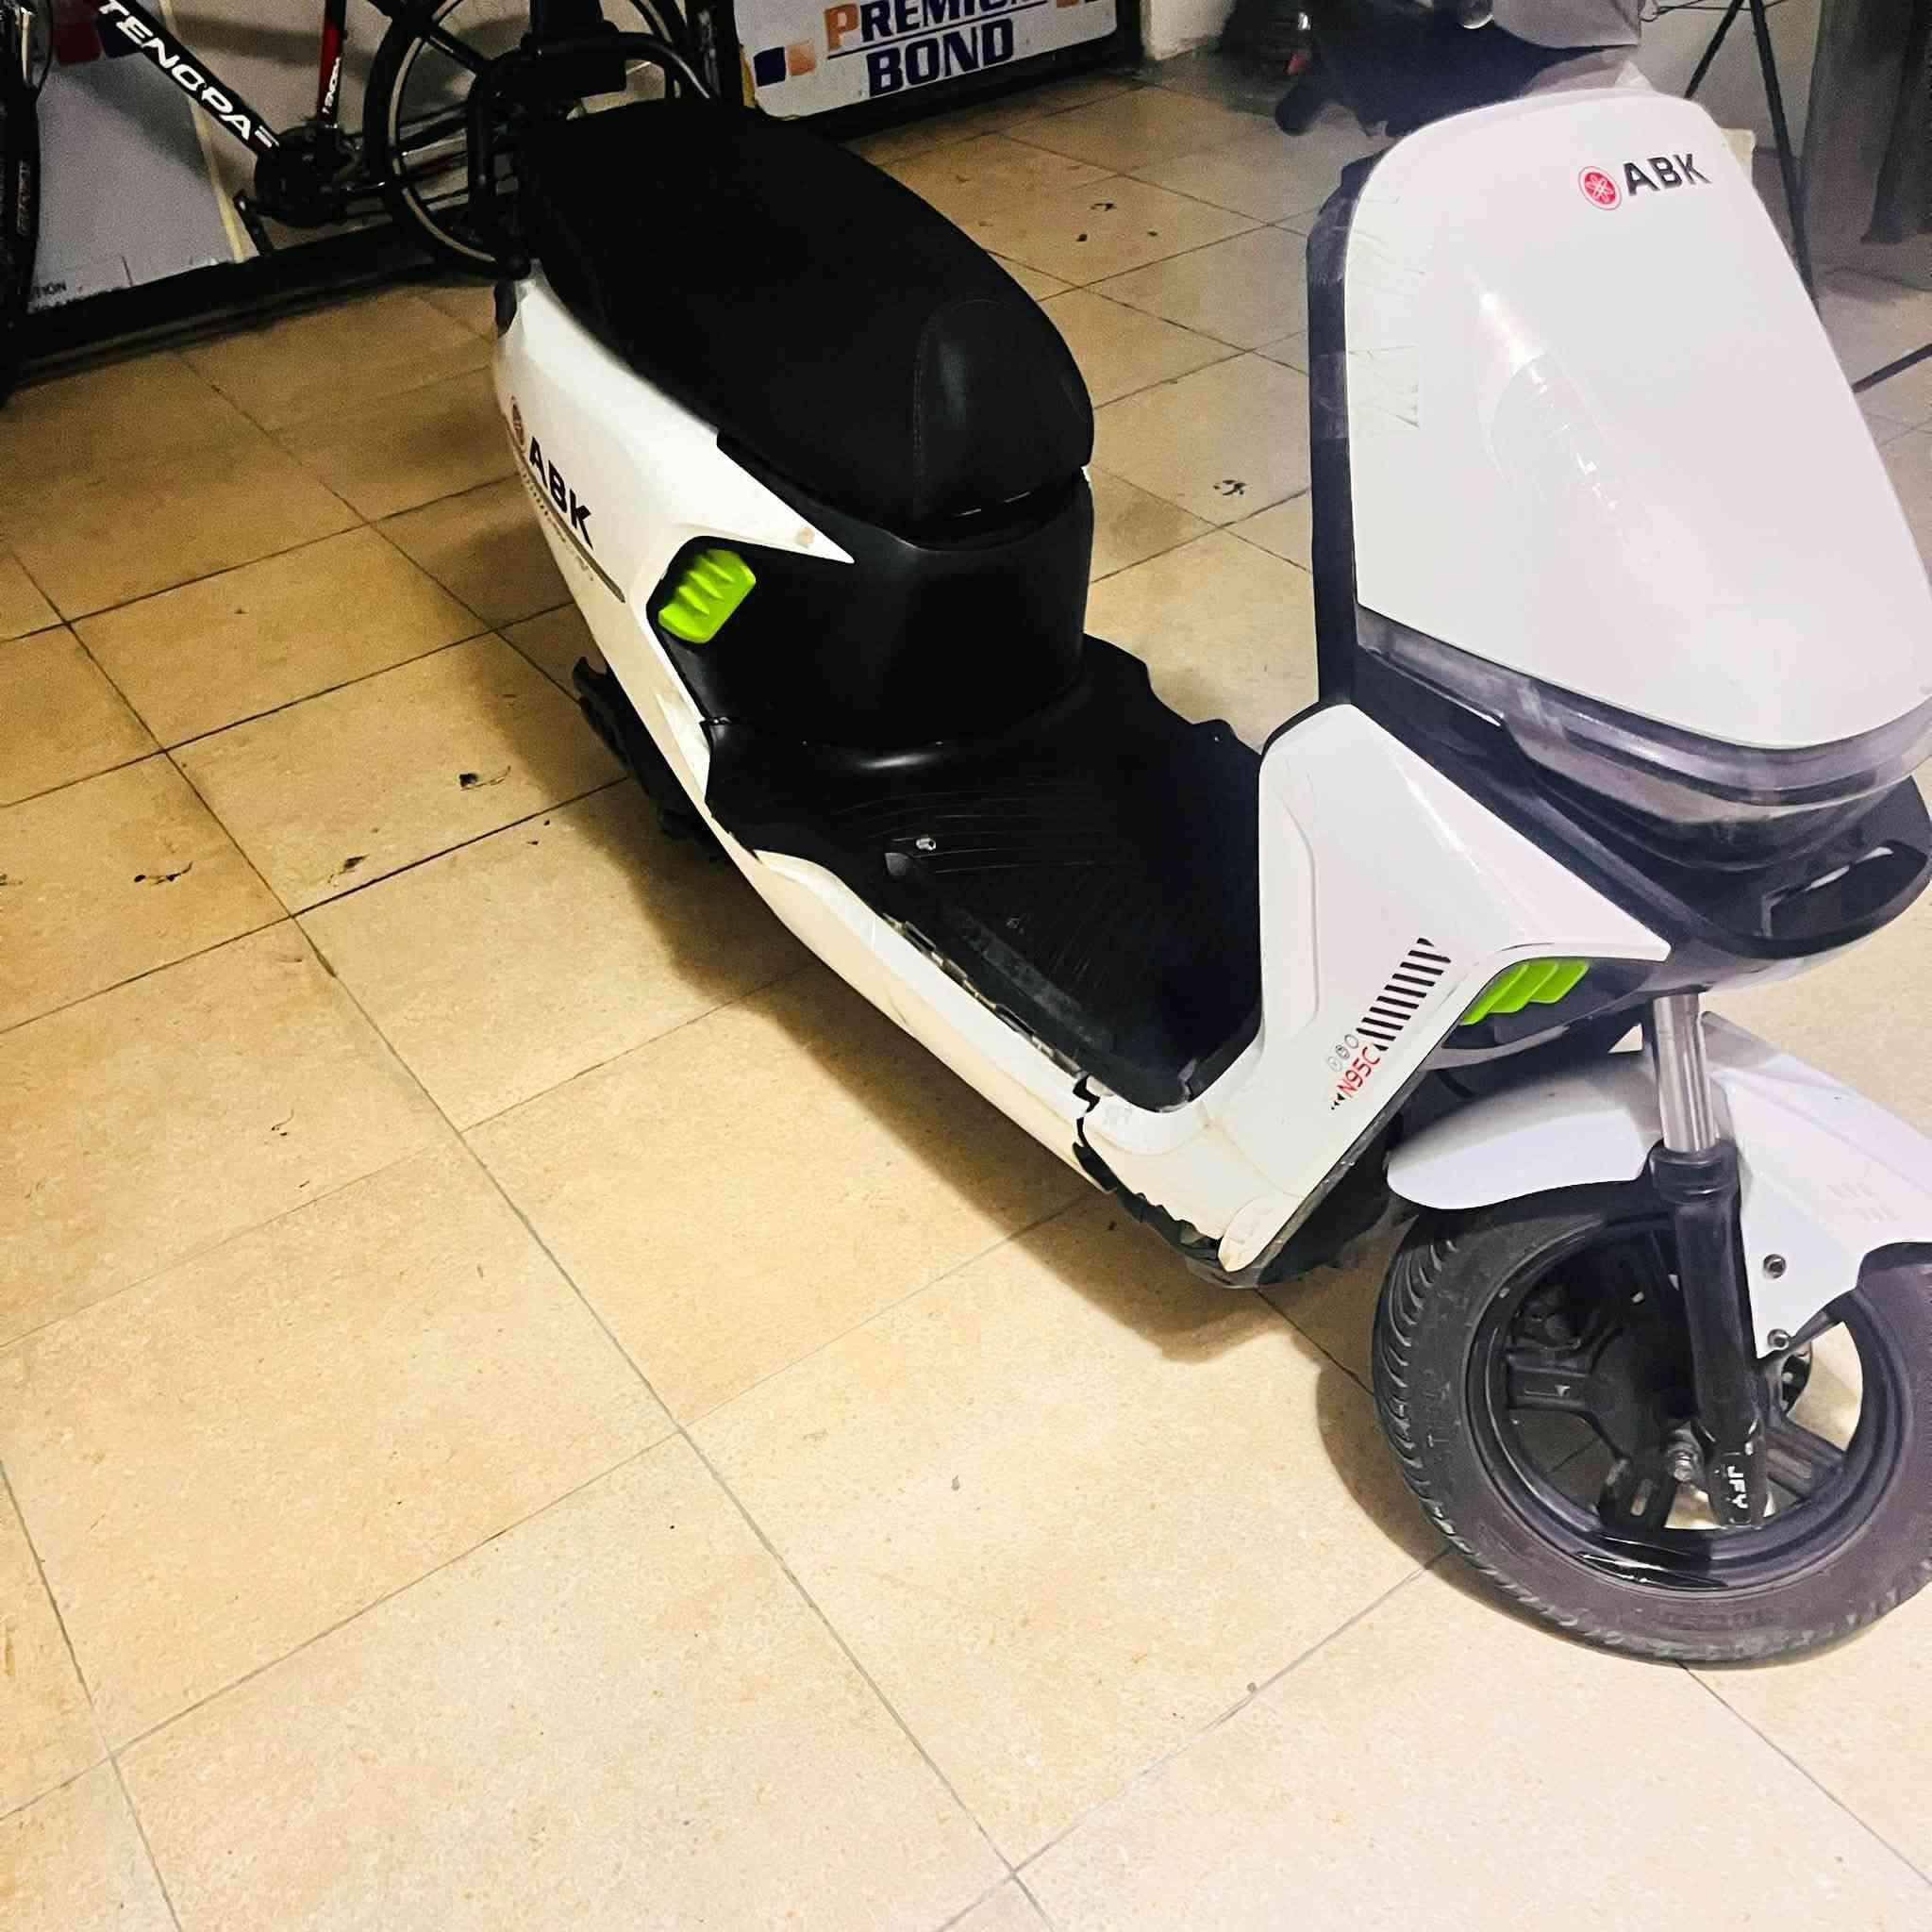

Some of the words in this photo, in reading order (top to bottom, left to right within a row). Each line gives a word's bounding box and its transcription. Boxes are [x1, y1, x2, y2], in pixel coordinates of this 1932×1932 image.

[824, 0, 1030, 52] PREM
[866, 18, 1014, 98] BOND
[1623, 154, 1712, 196] ABK
[528, 436, 593, 550] ABK
[1337, 1045, 1381, 1099] N95C
[1727, 1465, 1749, 1509] JFY
